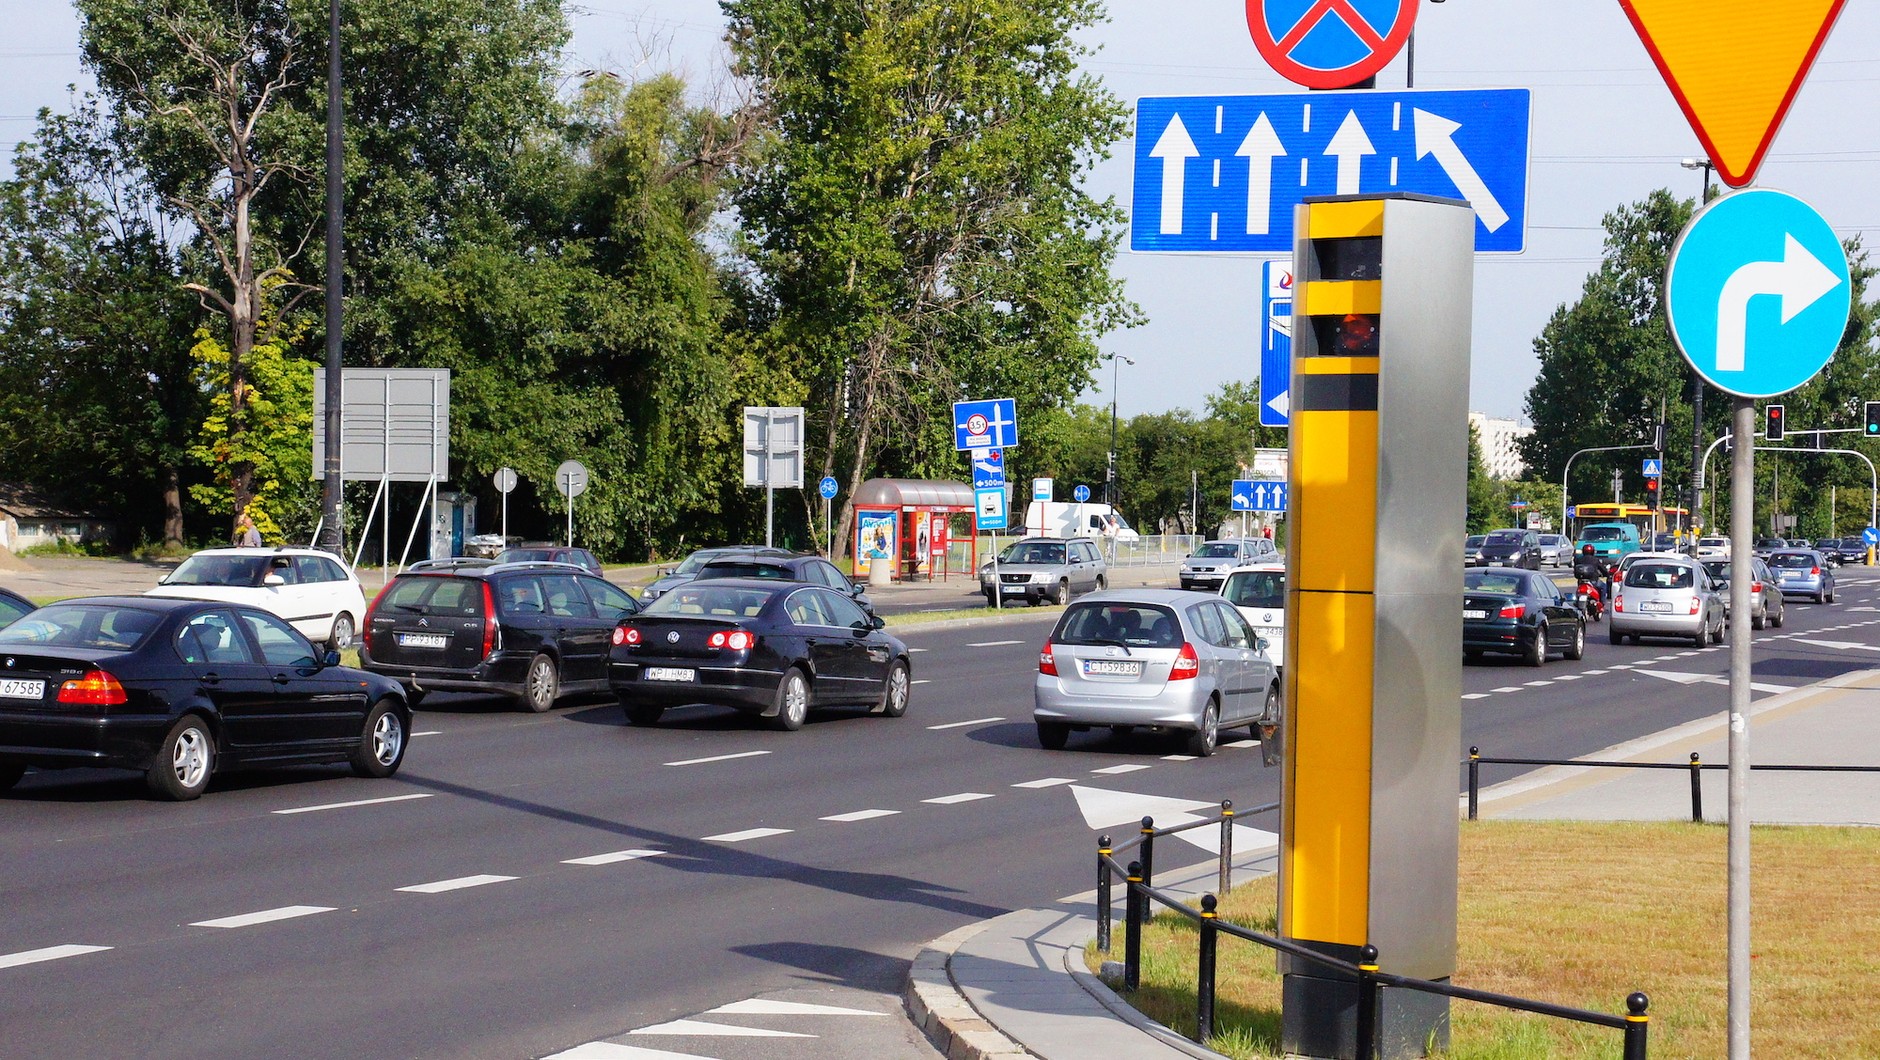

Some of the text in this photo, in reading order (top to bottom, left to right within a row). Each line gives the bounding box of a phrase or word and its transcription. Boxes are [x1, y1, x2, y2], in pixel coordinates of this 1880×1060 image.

[984, 479, 1004, 487] 500m
[1090, 661, 1105, 671] CT
[1108, 662, 1138, 673] 59836
[4, 681, 42, 695] 67585
